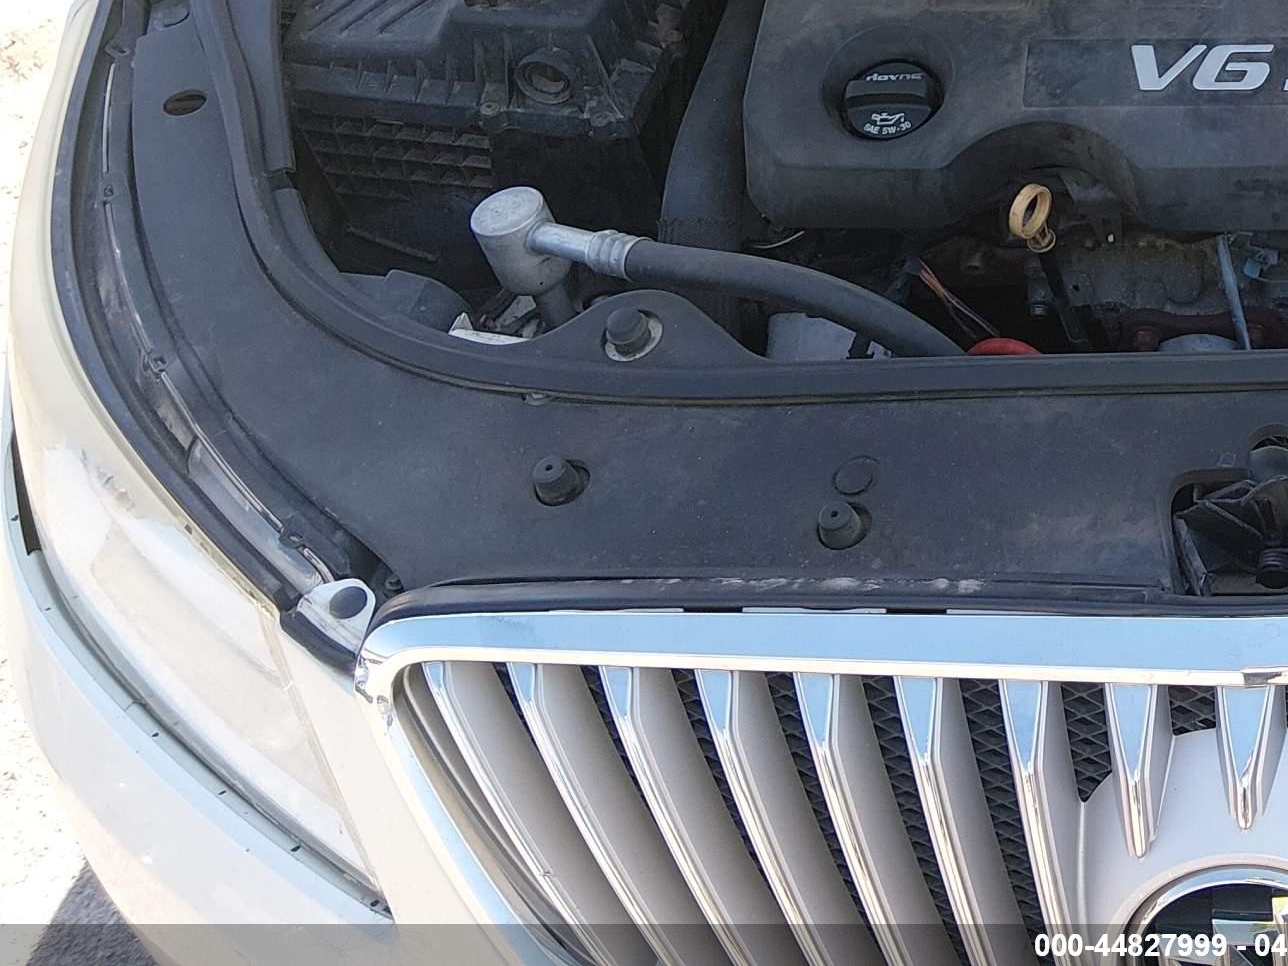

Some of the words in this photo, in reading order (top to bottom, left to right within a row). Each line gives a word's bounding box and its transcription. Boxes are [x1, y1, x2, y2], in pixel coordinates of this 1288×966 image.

[1131, 44, 1275, 91] V6
[864, 122, 880, 134] SAE
[881, 121, 912, 135] 5W-30
